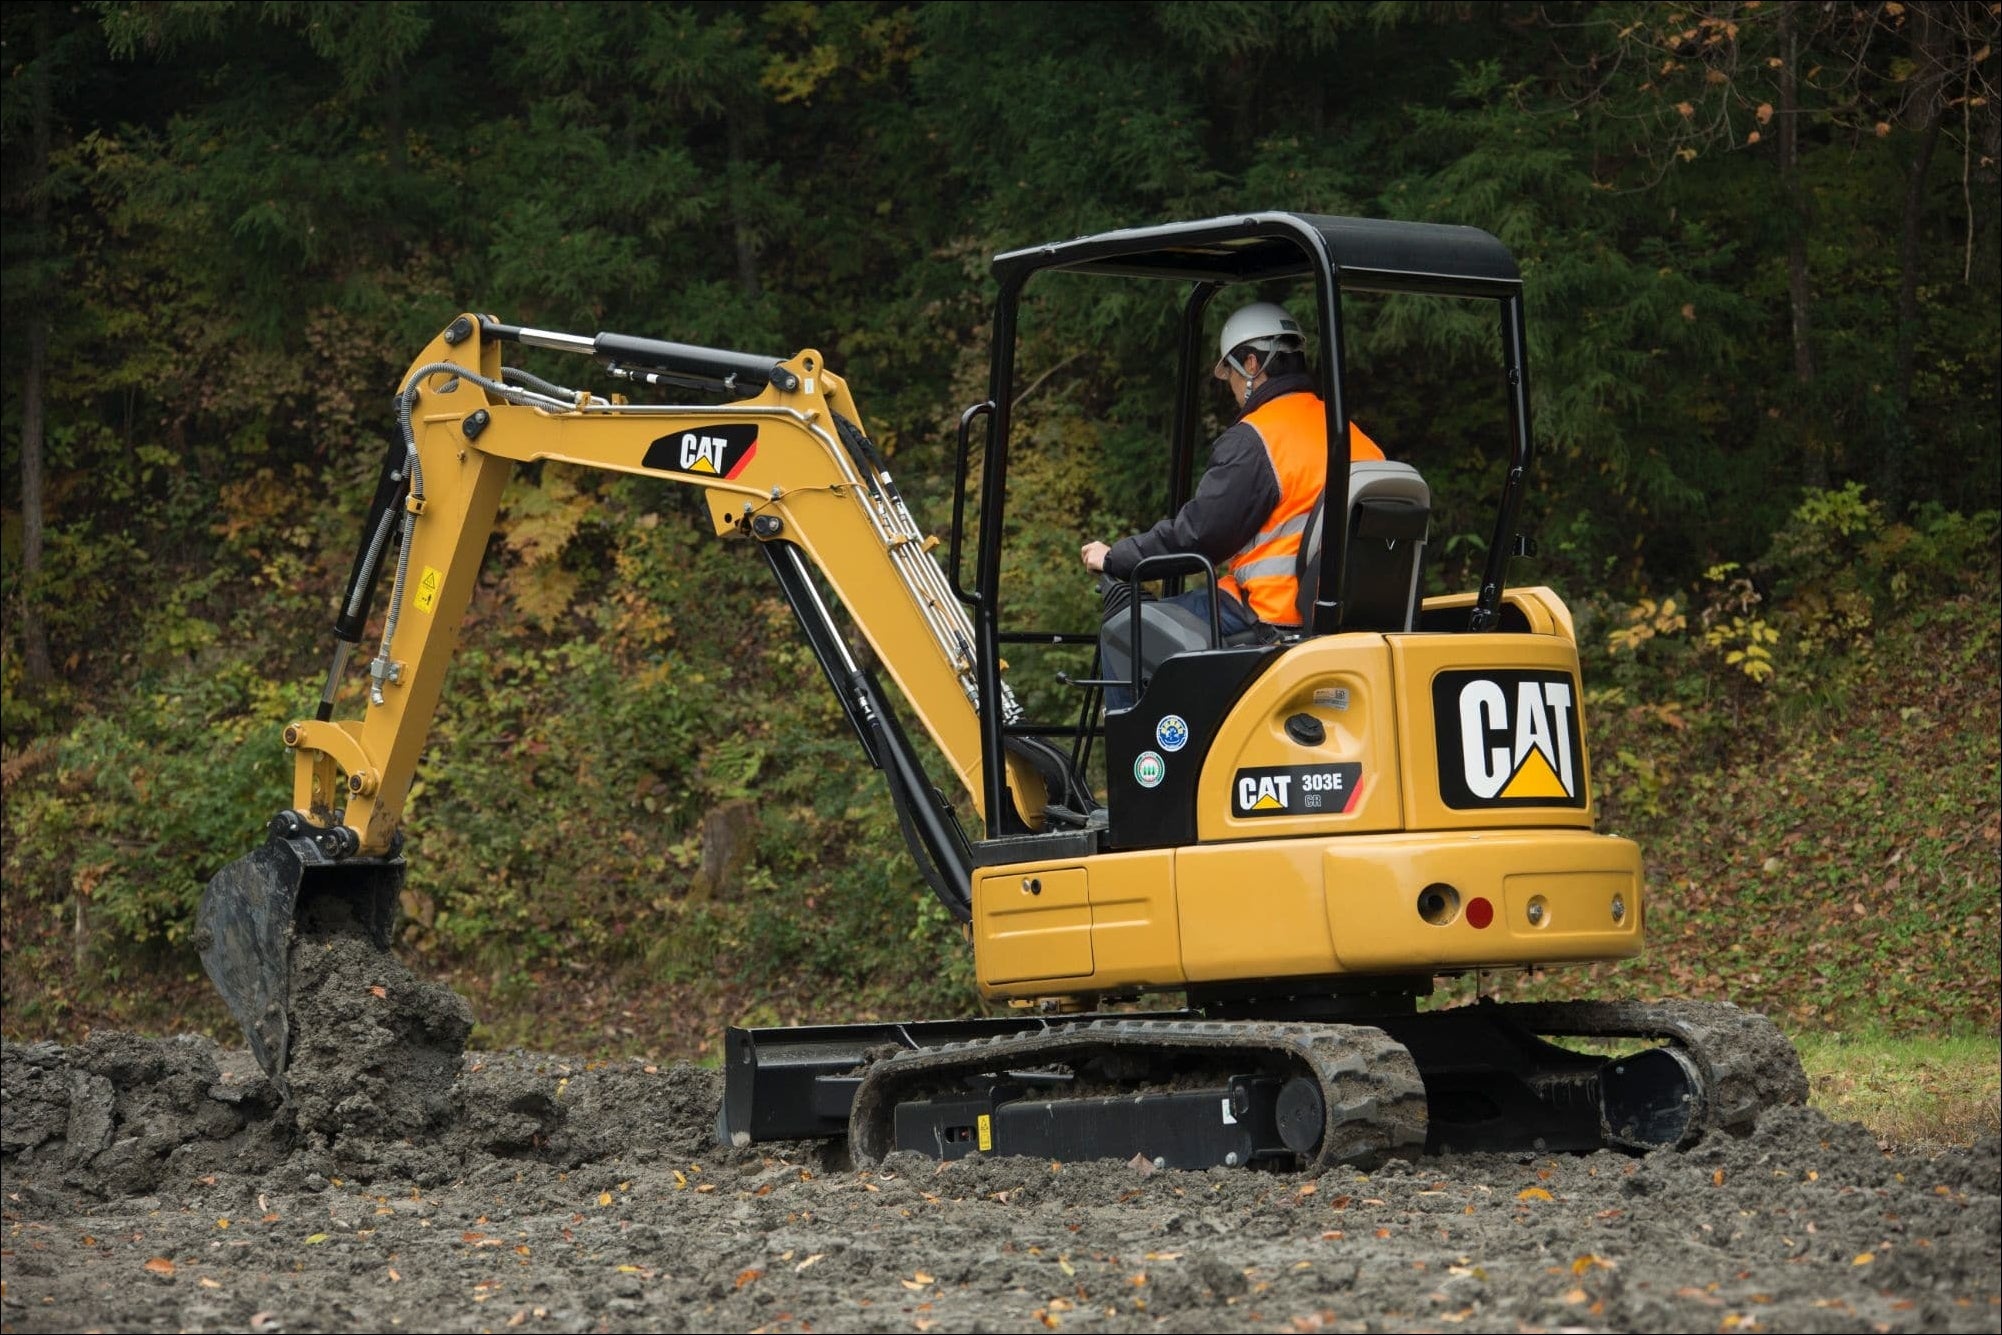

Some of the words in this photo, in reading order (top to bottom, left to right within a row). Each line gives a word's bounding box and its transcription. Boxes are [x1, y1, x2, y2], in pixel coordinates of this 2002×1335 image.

[680, 433, 727, 474] CAT
[1459, 680, 1575, 798] CAT
[1238, 775, 1292, 810] CAT
[1302, 773, 1343, 791] 303E
[1304, 795, 1321, 807] CR
